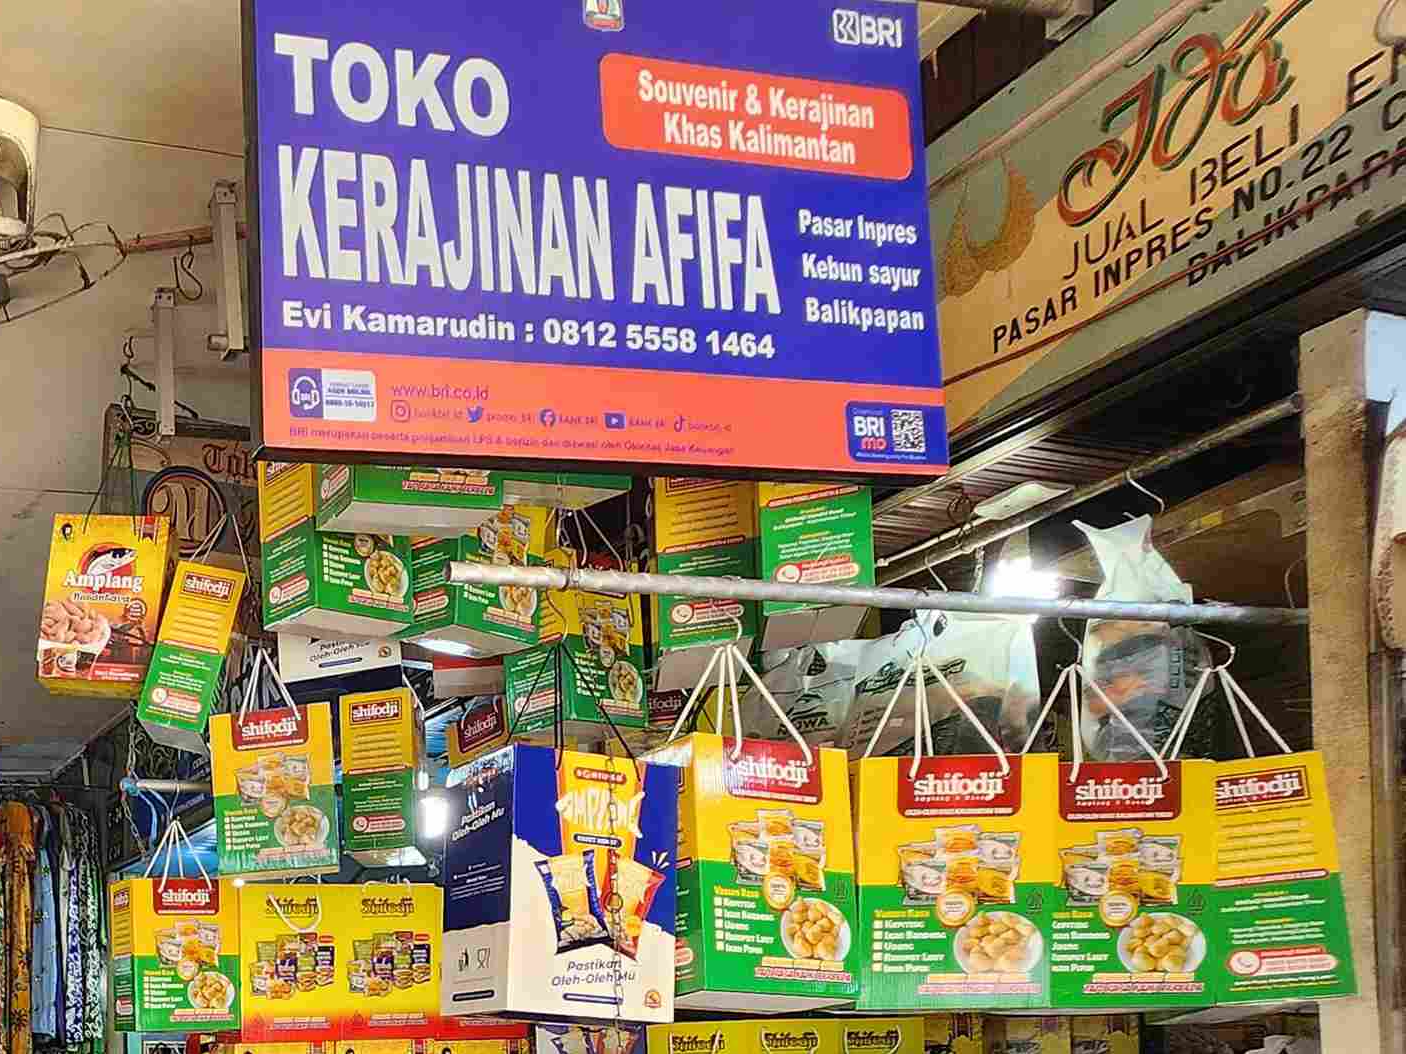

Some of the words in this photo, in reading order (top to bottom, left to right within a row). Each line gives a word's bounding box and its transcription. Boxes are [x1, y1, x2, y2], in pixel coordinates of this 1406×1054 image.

[860, 13, 902, 48] BRI
[274, 33, 510, 137] TOKO
[638, 70, 737, 112] Souvenir
[745, 91, 761, 113] &
[769, 93, 874, 132] Kerajinan
[664, 110, 723, 150] Khas
[729, 123, 856, 164] Kalimantan
[1063, 198, 1164, 281] JUAL
[1189, 104, 1300, 206] BELI
[278, 145, 614, 301] KERAJINAN
[632, 183, 781, 314] AFIFA
[799, 209, 854, 241] Pasar
[858, 215, 917, 246] Inpres
[802, 254, 863, 283] Kebun
[869, 263, 921, 292] sayur
[993, 284, 1077, 355] PASAR
[1094, 206, 1214, 298] INPRES
[282, 302, 333, 330] Evi
[343, 305, 516, 342] Kamarudin
[525, 324, 535, 344] :
[543, 318, 617, 350] 0812
[626, 323, 698, 354] 5558
[706, 328, 776, 360] 1464
[805, 298, 925, 332] Balikpapan
[853, 416, 885, 437] BRI
[62, 568, 144, 595] Amplang
[183, 572, 232, 600] shifodji
[351, 702, 400, 720] shifodji
[242, 716, 298, 742] shifodji
[737, 757, 810, 791] shifodji
[914, 772, 1005, 801] shifodji
[1074, 777, 1165, 805] shifodji
[1215, 772, 1302, 801] shifodji
[161, 887, 211, 909] shifodji
[551, 971, 614, 987] Oleh-Oleh
[567, 958, 623, 973] Pastikan
